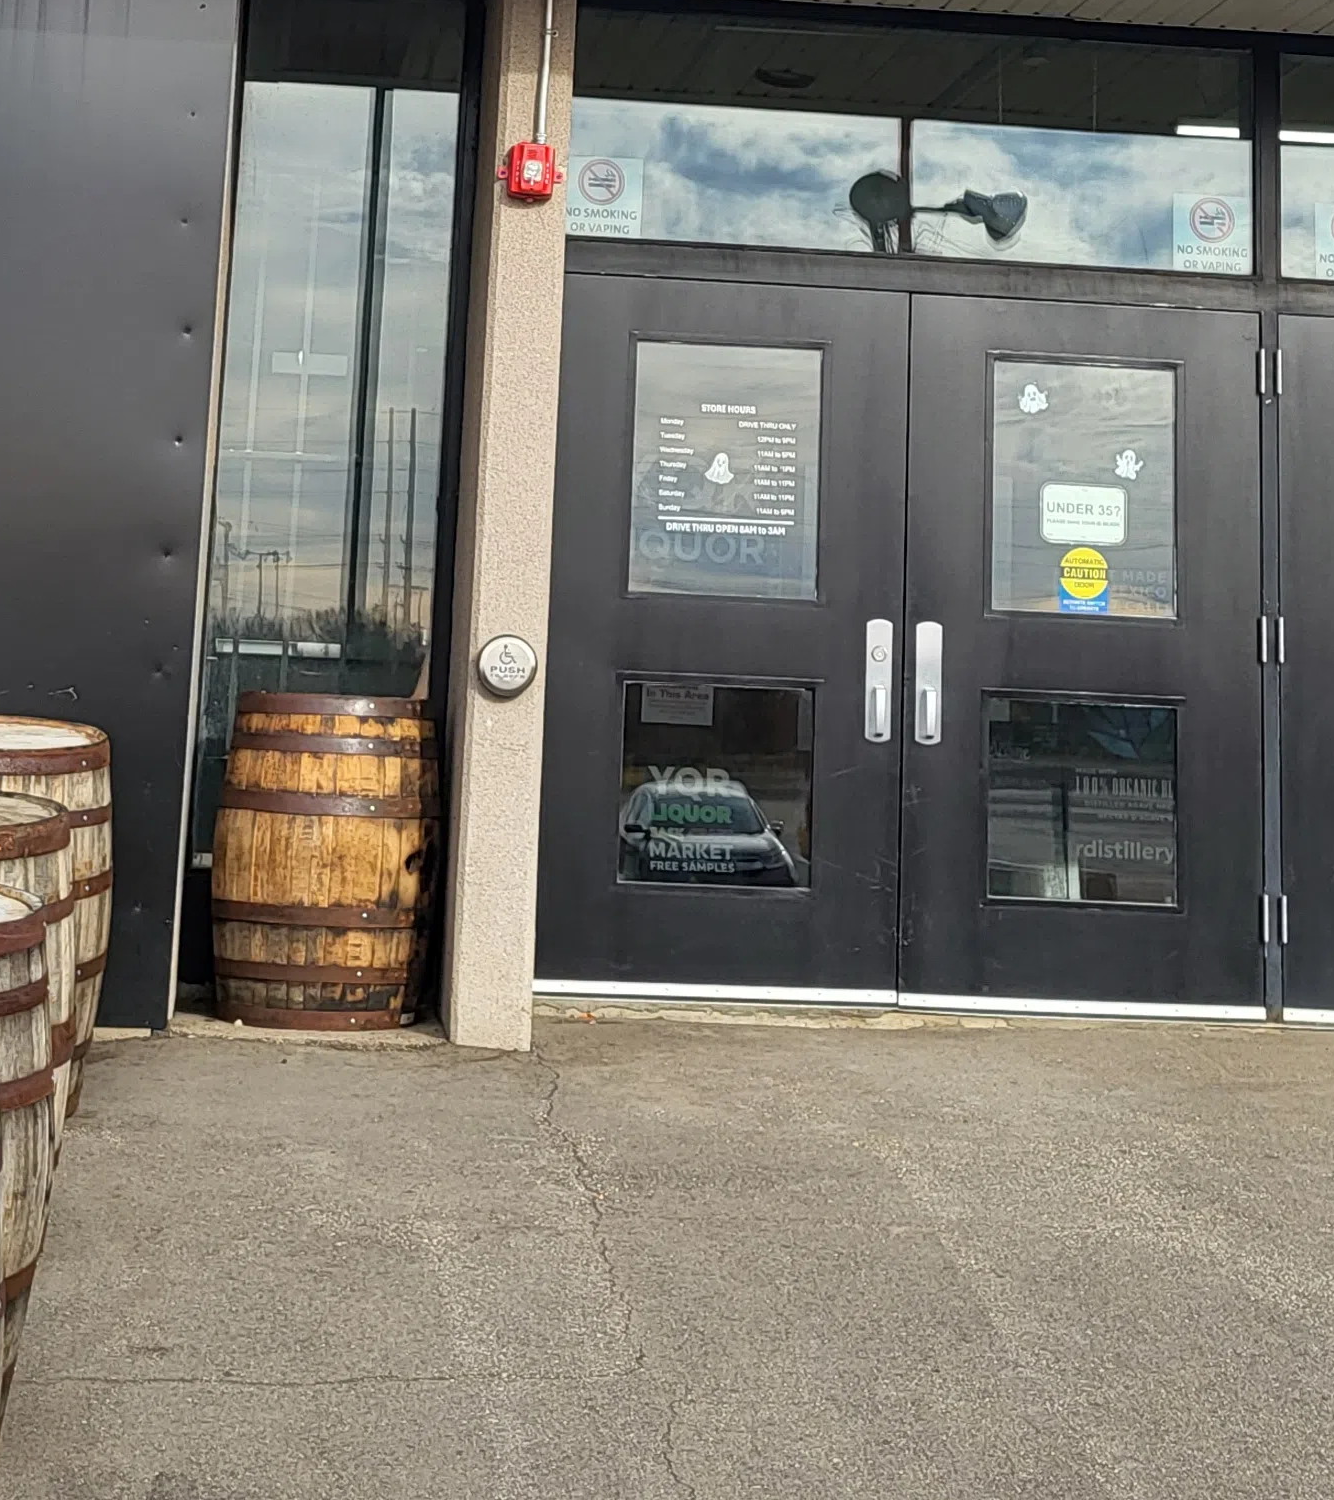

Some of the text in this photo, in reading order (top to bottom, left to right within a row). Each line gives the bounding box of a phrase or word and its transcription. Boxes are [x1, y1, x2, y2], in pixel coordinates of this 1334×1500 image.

[565, 207, 637, 220] NO SMOKING
[570, 222, 630, 234] OR VAPING
[1177, 245, 1248, 258] NO SMOKING
[1183, 260, 1241, 272] OR VAPING
[701, 404, 756, 415] STORE HOURS
[1047, 501, 1121, 517] UNDER 35?
[666, 522, 690, 532] DRIVE
[692, 524, 714, 532] THRU
[716, 524, 738, 533] OPEN
[758, 526, 767, 535] to
[1065, 557, 1104, 565] AUTOMATIC
[1064, 567, 1106, 580] CAUTION
[490, 666, 525, 674] PUSH
[648, 766, 731, 801] YQR
[1112, 777, 1158, 797] ORGANIC
[651, 804, 733, 824] LIQUOR
[649, 842, 734, 860] MARKET
[651, 861, 735, 873] FREE SAMPLES
